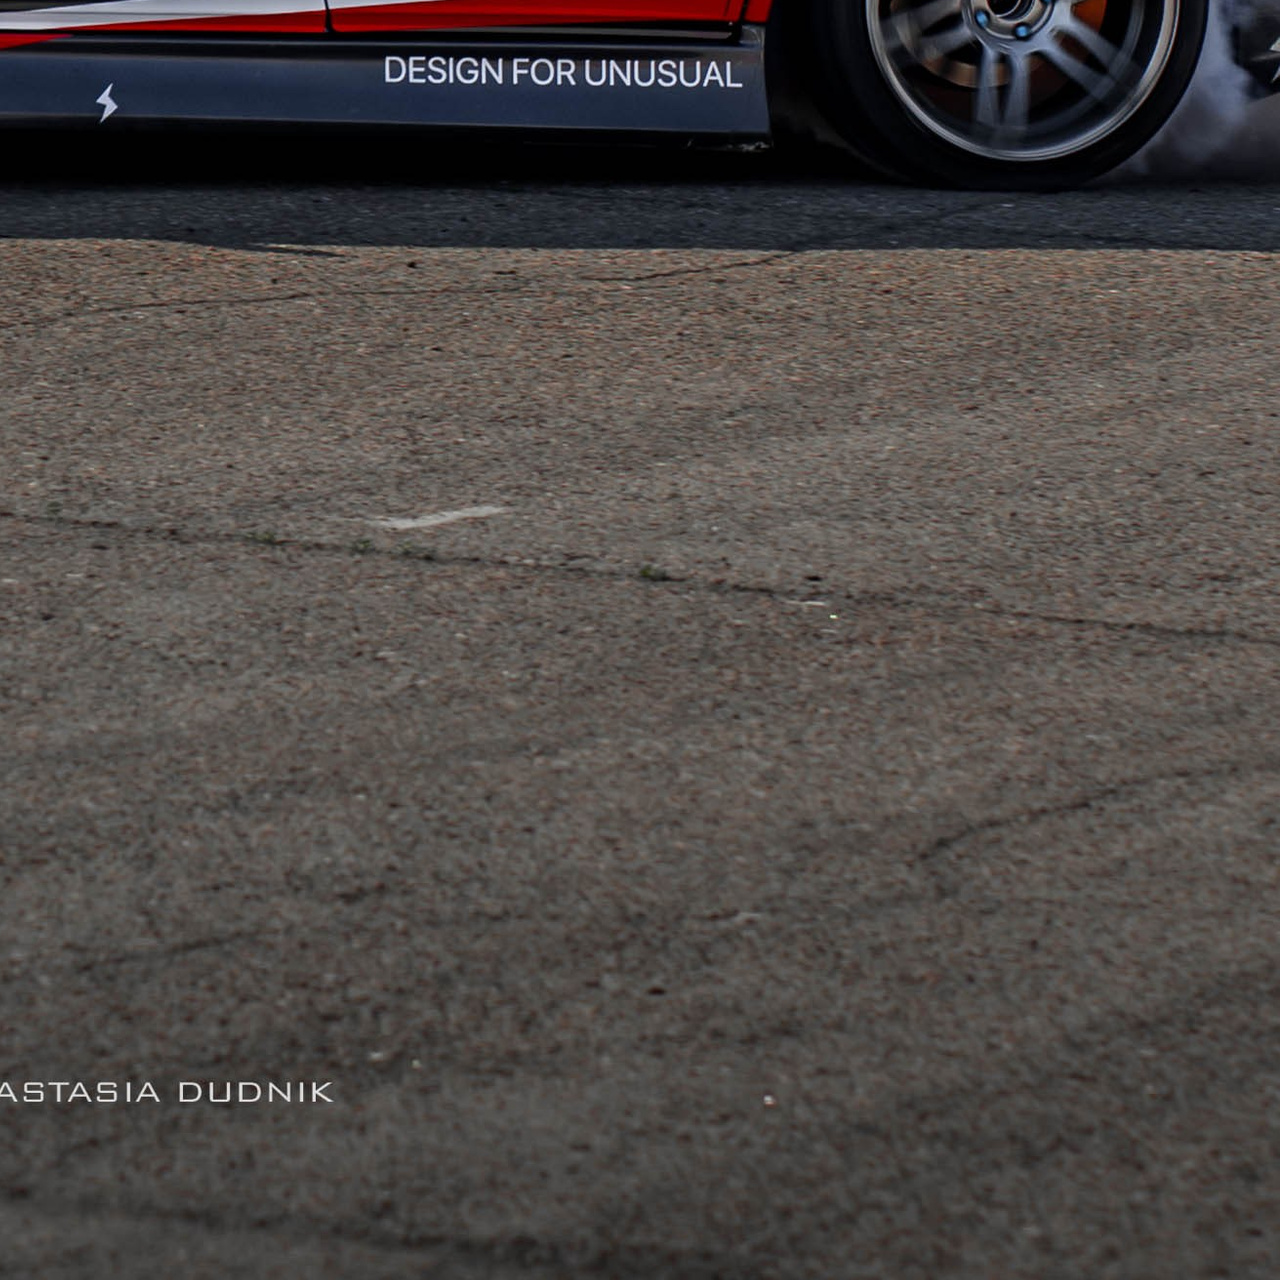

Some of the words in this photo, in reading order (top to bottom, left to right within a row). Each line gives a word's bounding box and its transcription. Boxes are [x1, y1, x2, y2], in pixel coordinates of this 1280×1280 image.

[384, 56, 503, 85] DESIGN
[512, 58, 576, 86] FOR
[584, 59, 743, 88] UNUSUAL
